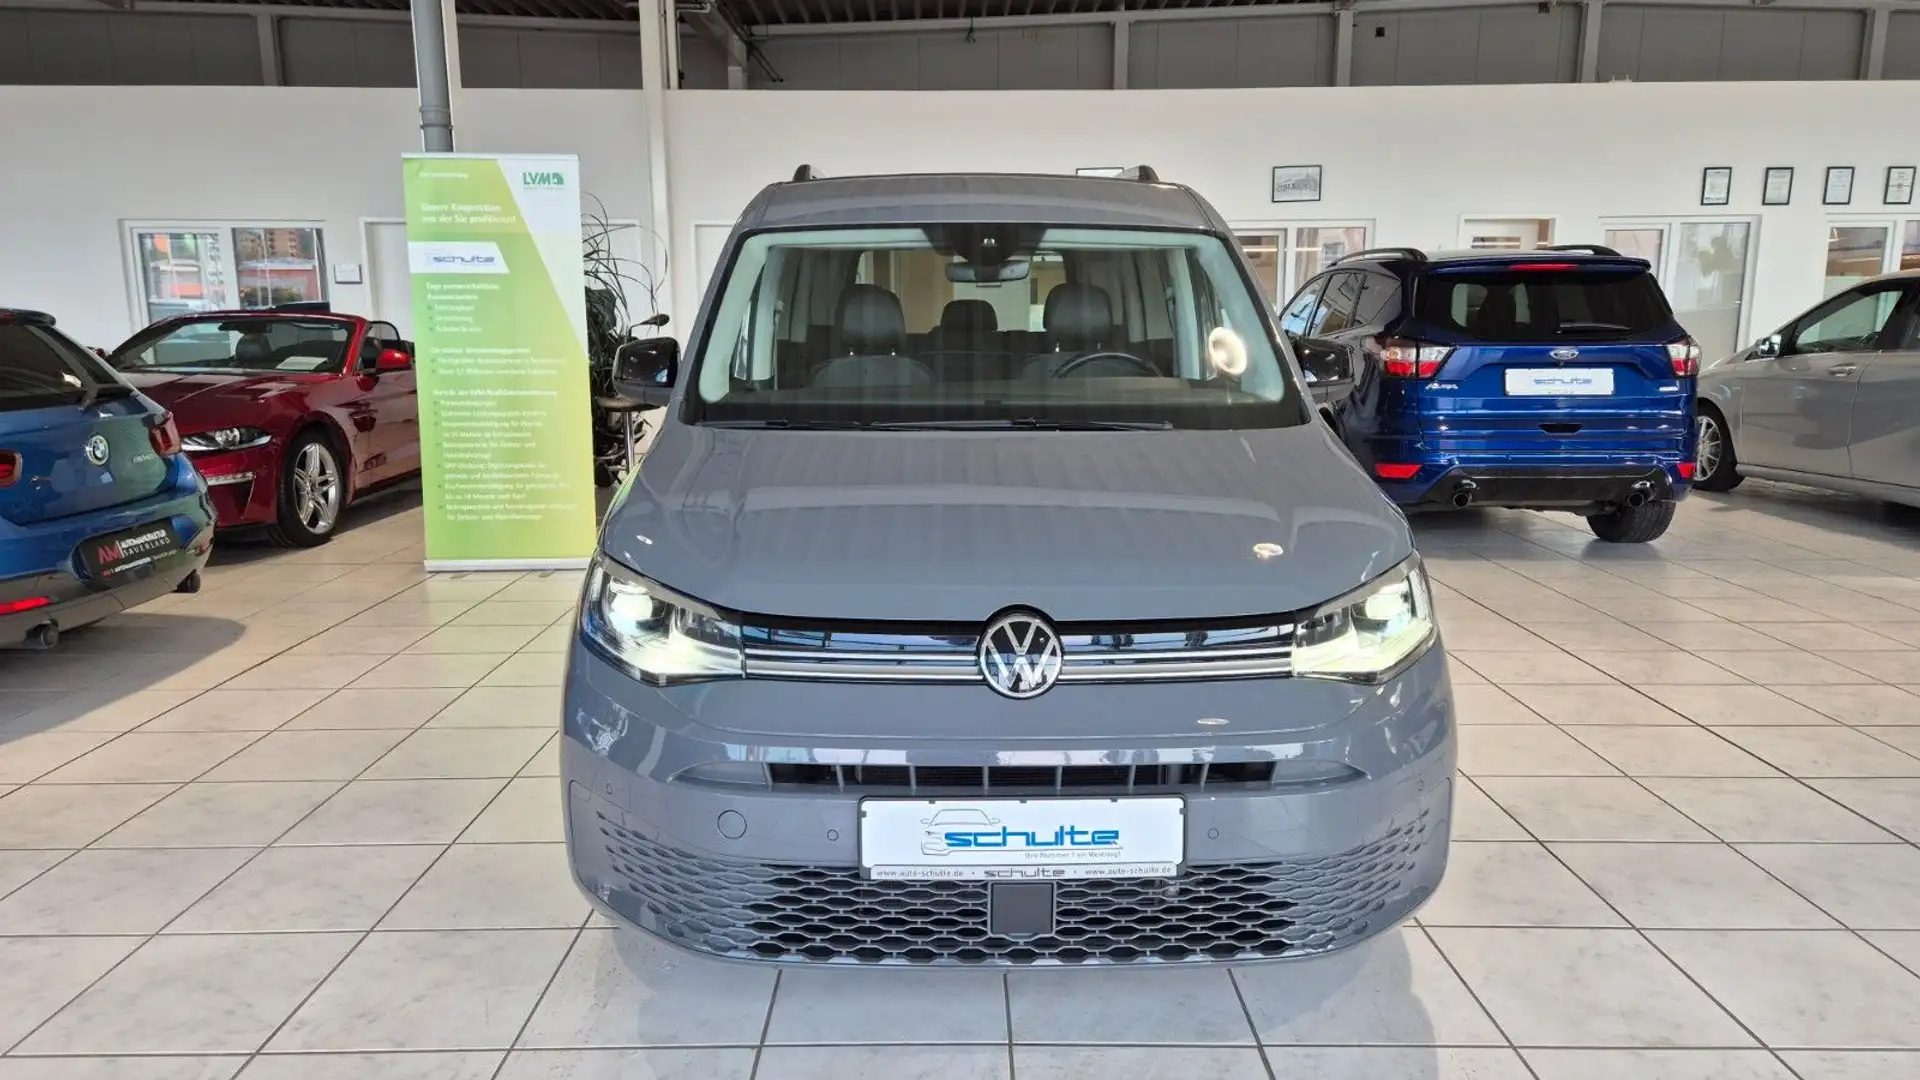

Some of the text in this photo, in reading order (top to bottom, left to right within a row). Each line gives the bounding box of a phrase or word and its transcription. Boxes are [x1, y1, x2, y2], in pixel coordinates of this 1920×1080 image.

[522, 171, 550, 186] LVM
[122, 536, 171, 557] SAUERLAND
[944, 825, 1119, 848] schulte
[876, 866, 1172, 878] www.auto-schulte.de schulte www.auto-schulte.de
